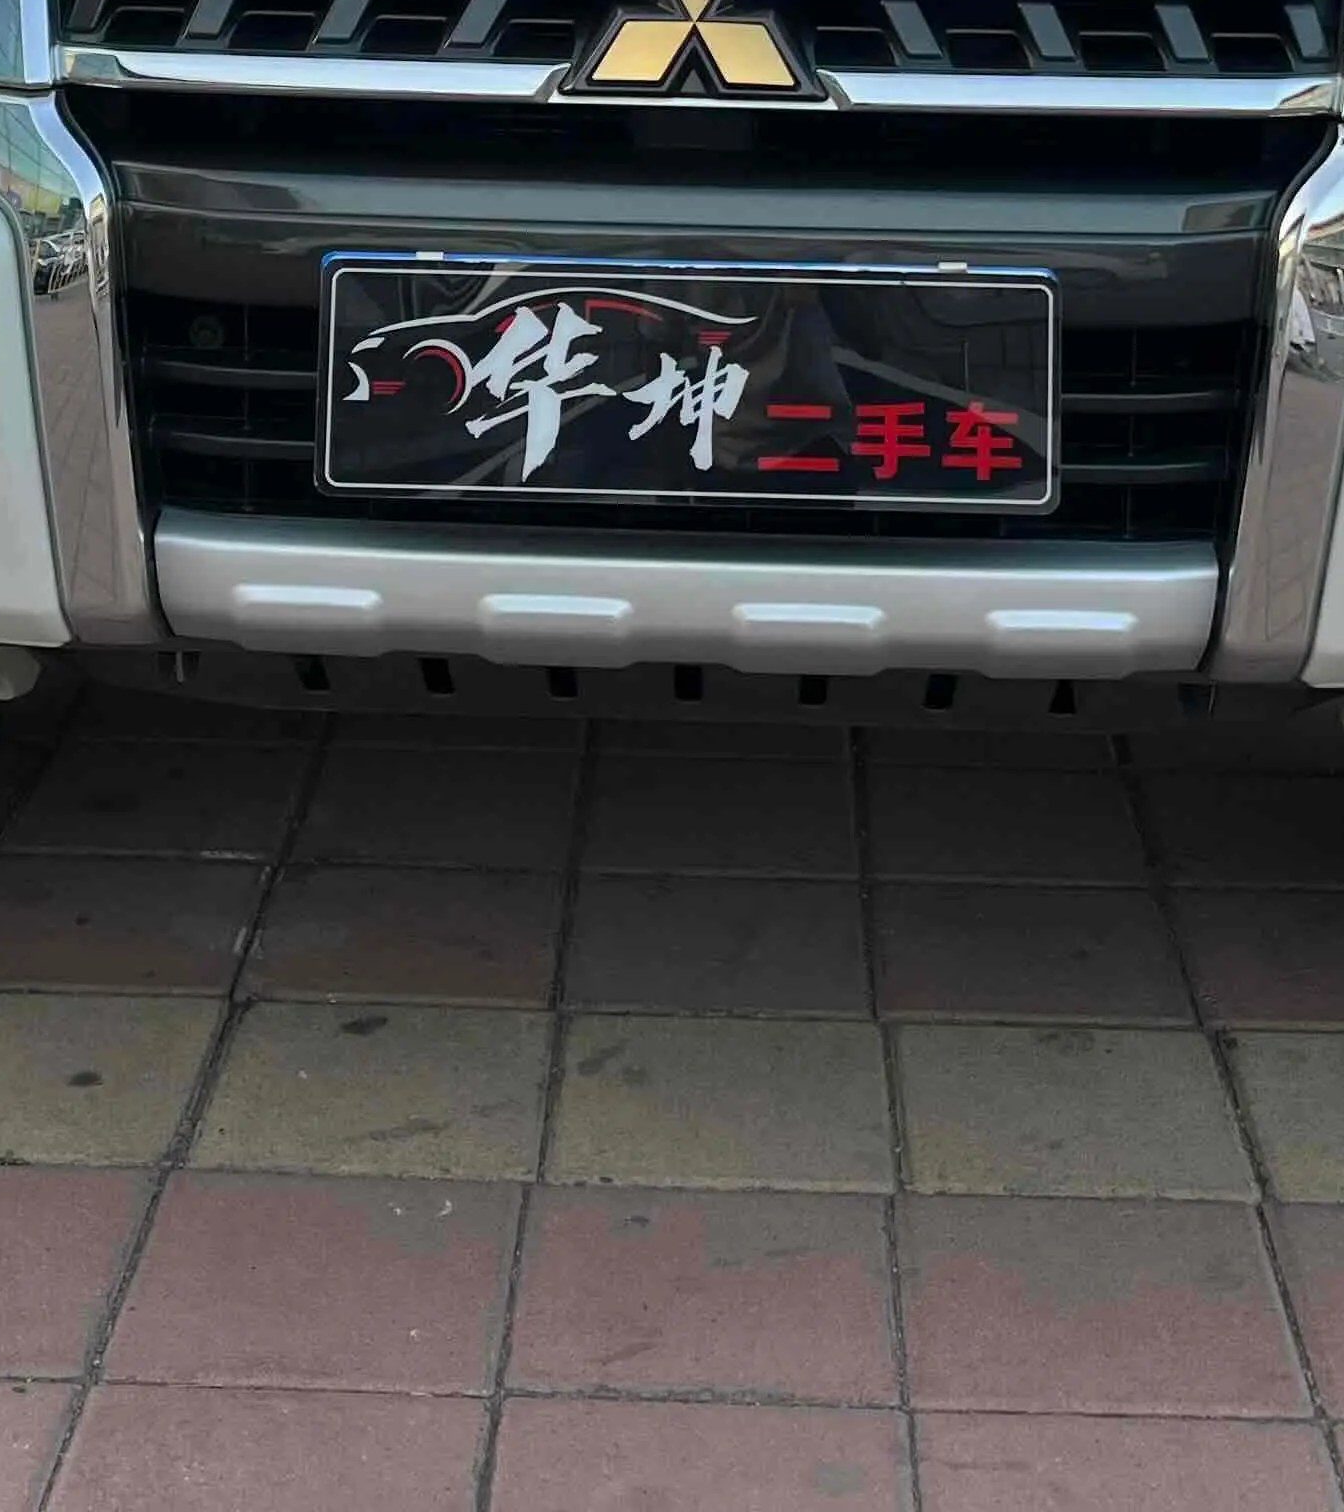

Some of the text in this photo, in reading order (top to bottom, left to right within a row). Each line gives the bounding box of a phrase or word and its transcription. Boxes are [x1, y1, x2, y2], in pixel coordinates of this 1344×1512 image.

[466, 302, 1022, 482] 华坤 二手车
